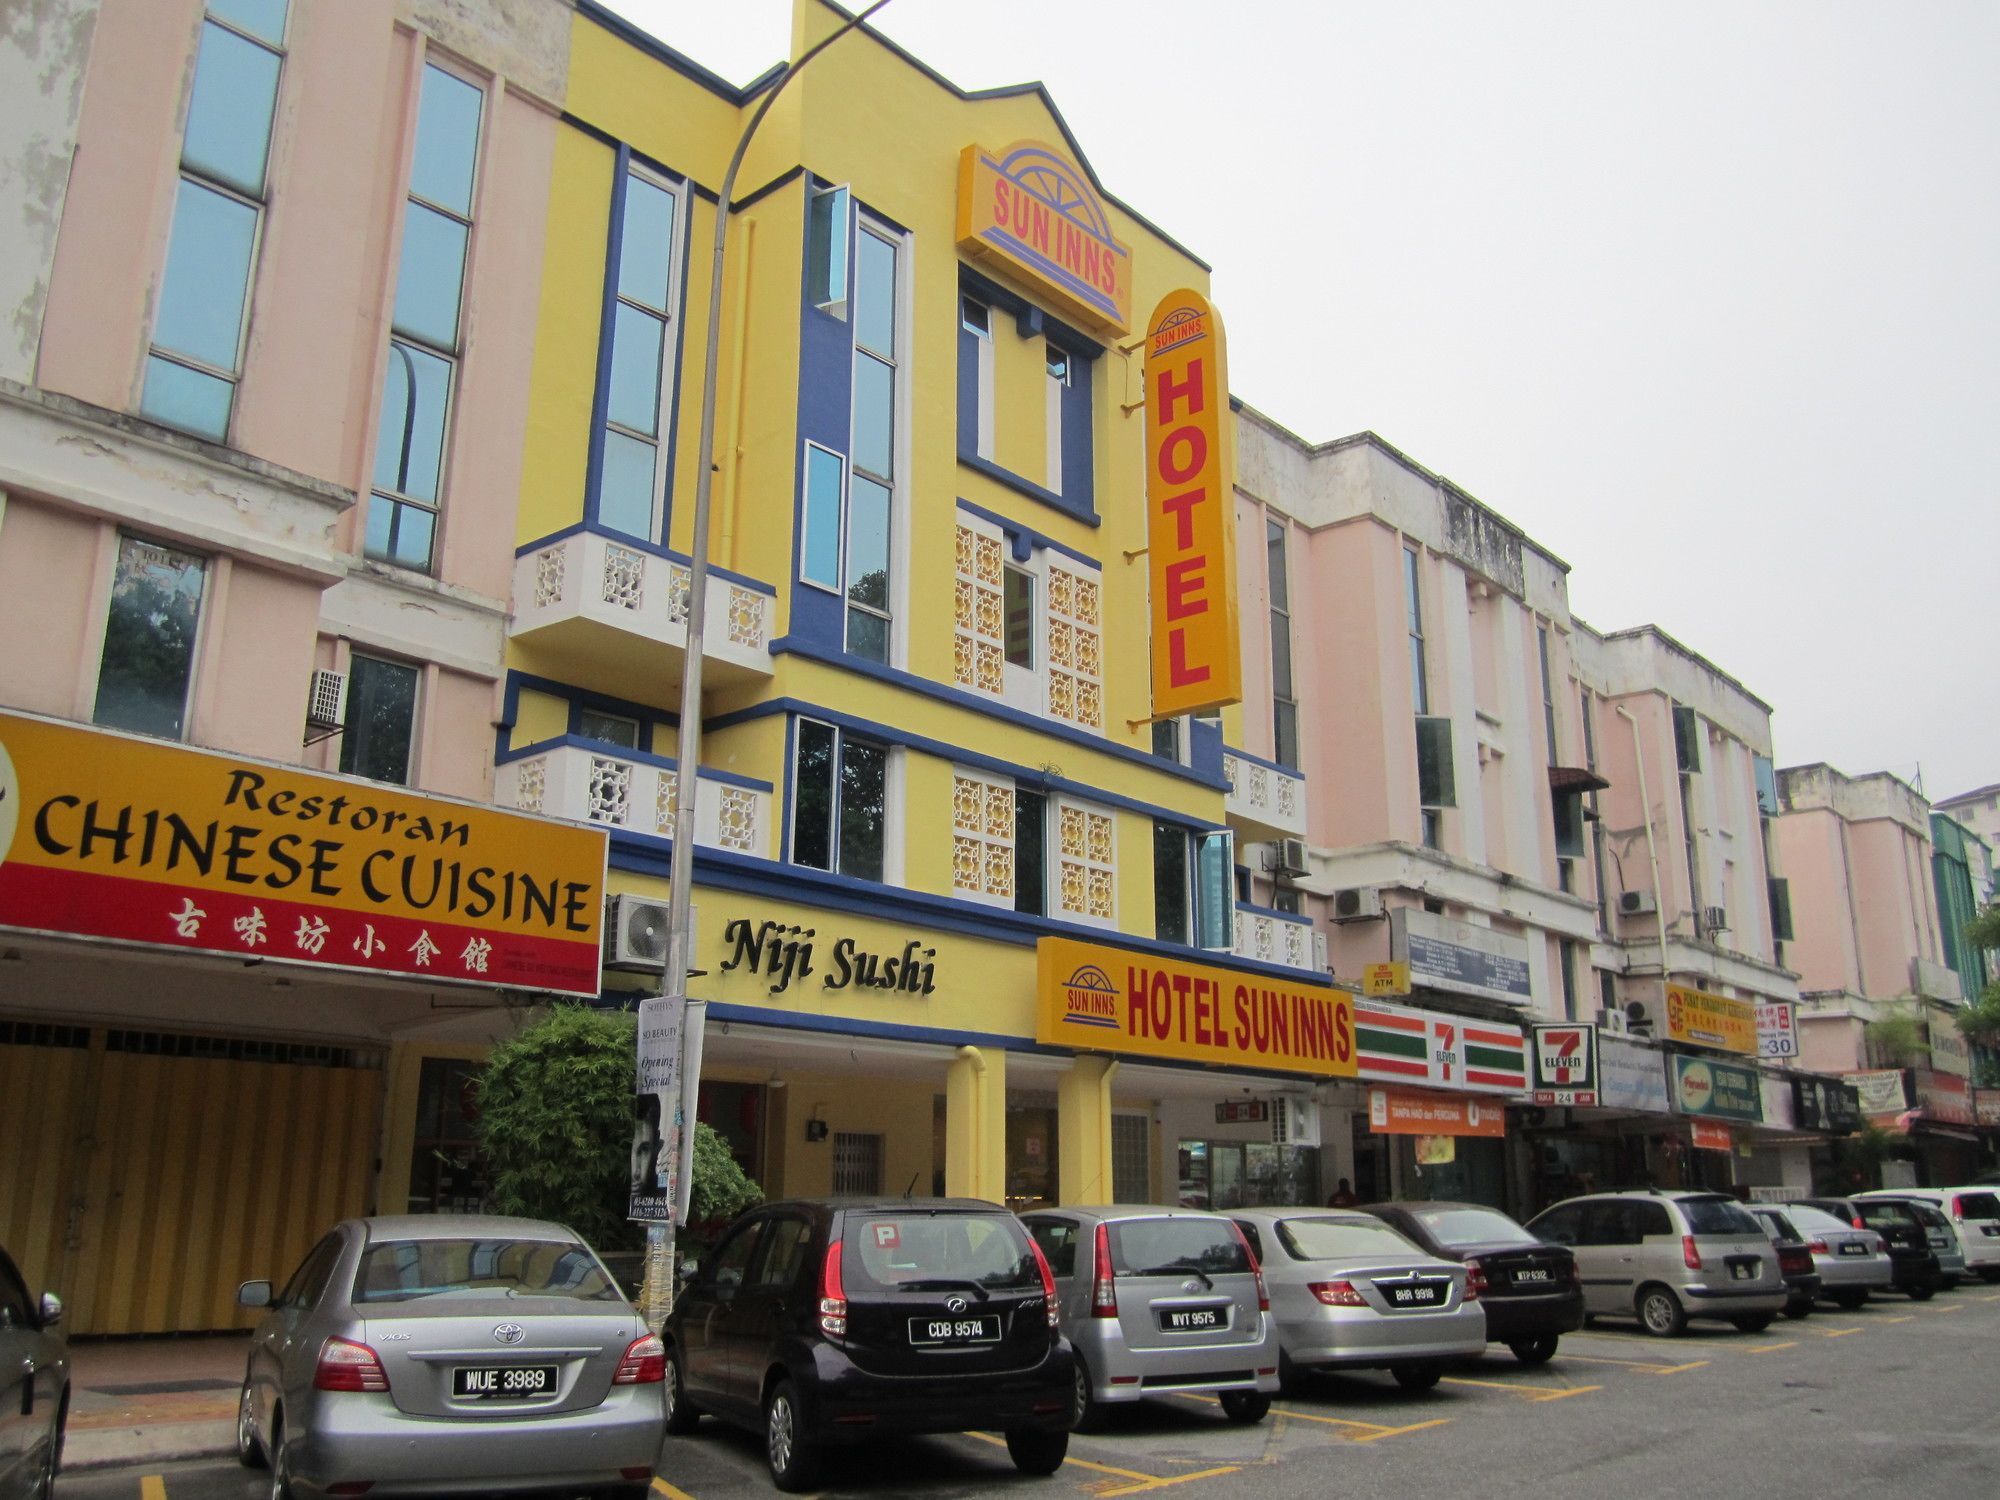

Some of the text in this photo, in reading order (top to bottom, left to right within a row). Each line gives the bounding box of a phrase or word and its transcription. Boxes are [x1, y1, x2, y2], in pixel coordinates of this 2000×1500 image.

[993, 177, 1116, 295] SUN INNS
[1155, 320, 1201, 347] SUN INNS
[1157, 358, 1210, 689] HOTEL
[224, 769, 469, 847] Restoran
[34, 795, 593, 933] CHINESE CUISINE
[168, 897, 493, 973] 古味坊小食館
[719, 919, 936, 996] Niji Sushi
[1374, 978, 1393, 987] ATM
[1067, 989, 1115, 1016] SUN INNS
[1128, 966, 1350, 1063] HOTEL SUN INNS
[652, 1026, 677, 1039] BEAUTY
[1768, 1038, 1791, 1054] 30
[641, 1055, 674, 1071] Opening
[1434, 1022, 1455, 1081] 7
[1544, 1031, 1580, 1084] 7
[641, 1073, 672, 1091] Special
[1558, 1093, 1571, 1103] 24
[878, 1225, 896, 1246] P
[928, 1320, 983, 1338] CDB 9574
[1171, 1310, 1215, 1326] WVT 9575
[466, 1368, 546, 1391] WUE 3989
